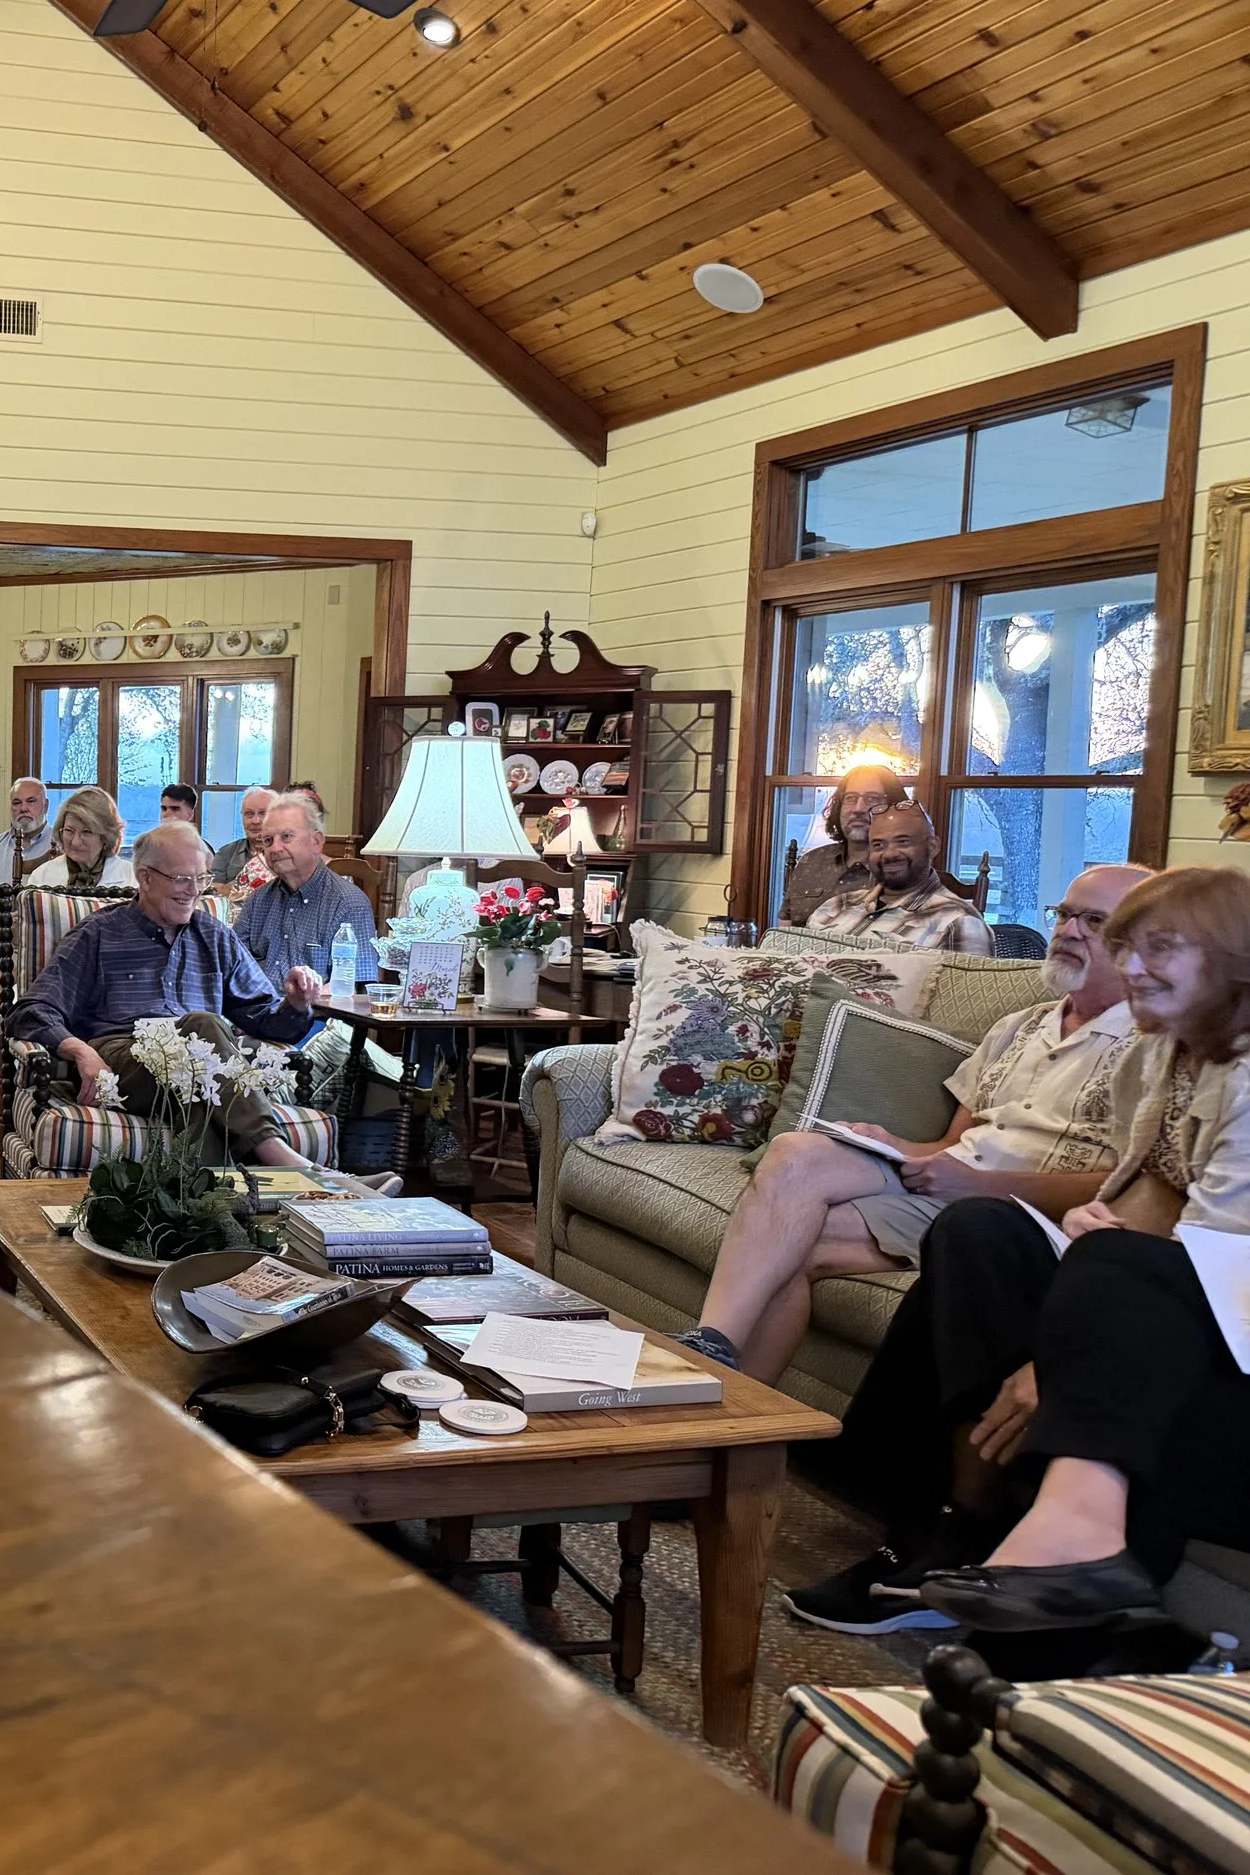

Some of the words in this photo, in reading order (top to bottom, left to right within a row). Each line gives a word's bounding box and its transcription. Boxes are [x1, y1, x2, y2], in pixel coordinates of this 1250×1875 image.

[368, 1232, 402, 1240] LIVING
[333, 1248, 369, 1256] PATINA
[372, 1246, 399, 1255] FARM
[335, 1263, 380, 1275] PATINA
[414, 1263, 449, 1271] GARDENS
[578, 1393, 612, 1406] Going
[618, 1391, 640, 1402] West
